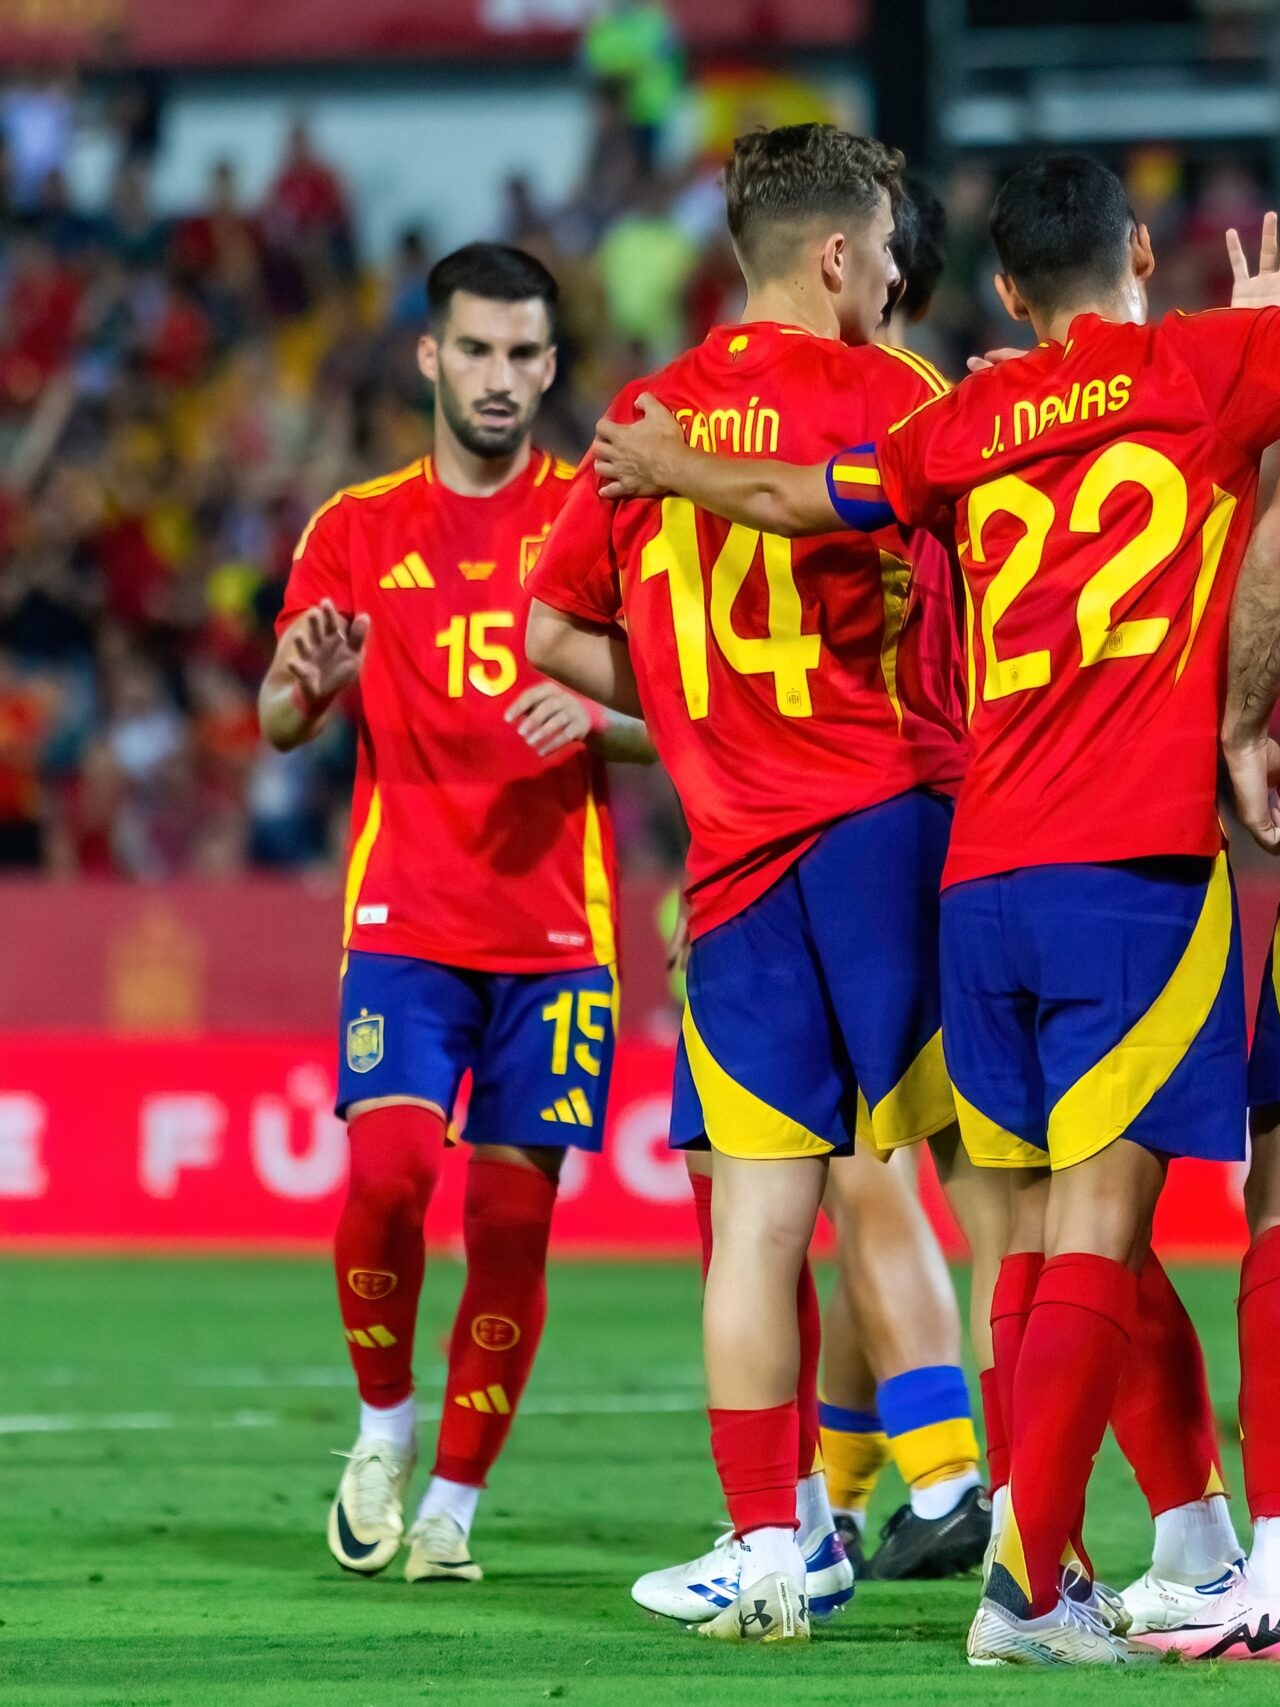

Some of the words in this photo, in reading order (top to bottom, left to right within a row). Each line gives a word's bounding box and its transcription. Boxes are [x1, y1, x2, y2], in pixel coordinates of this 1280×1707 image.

[981, 415, 1005, 459] J.
[1013, 373, 1133, 446] NAVAS
[640, 496, 823, 721] 14
[967, 441, 1189, 702] 22
[435, 610, 518, 699] 15
[542, 989, 611, 1077] 15
